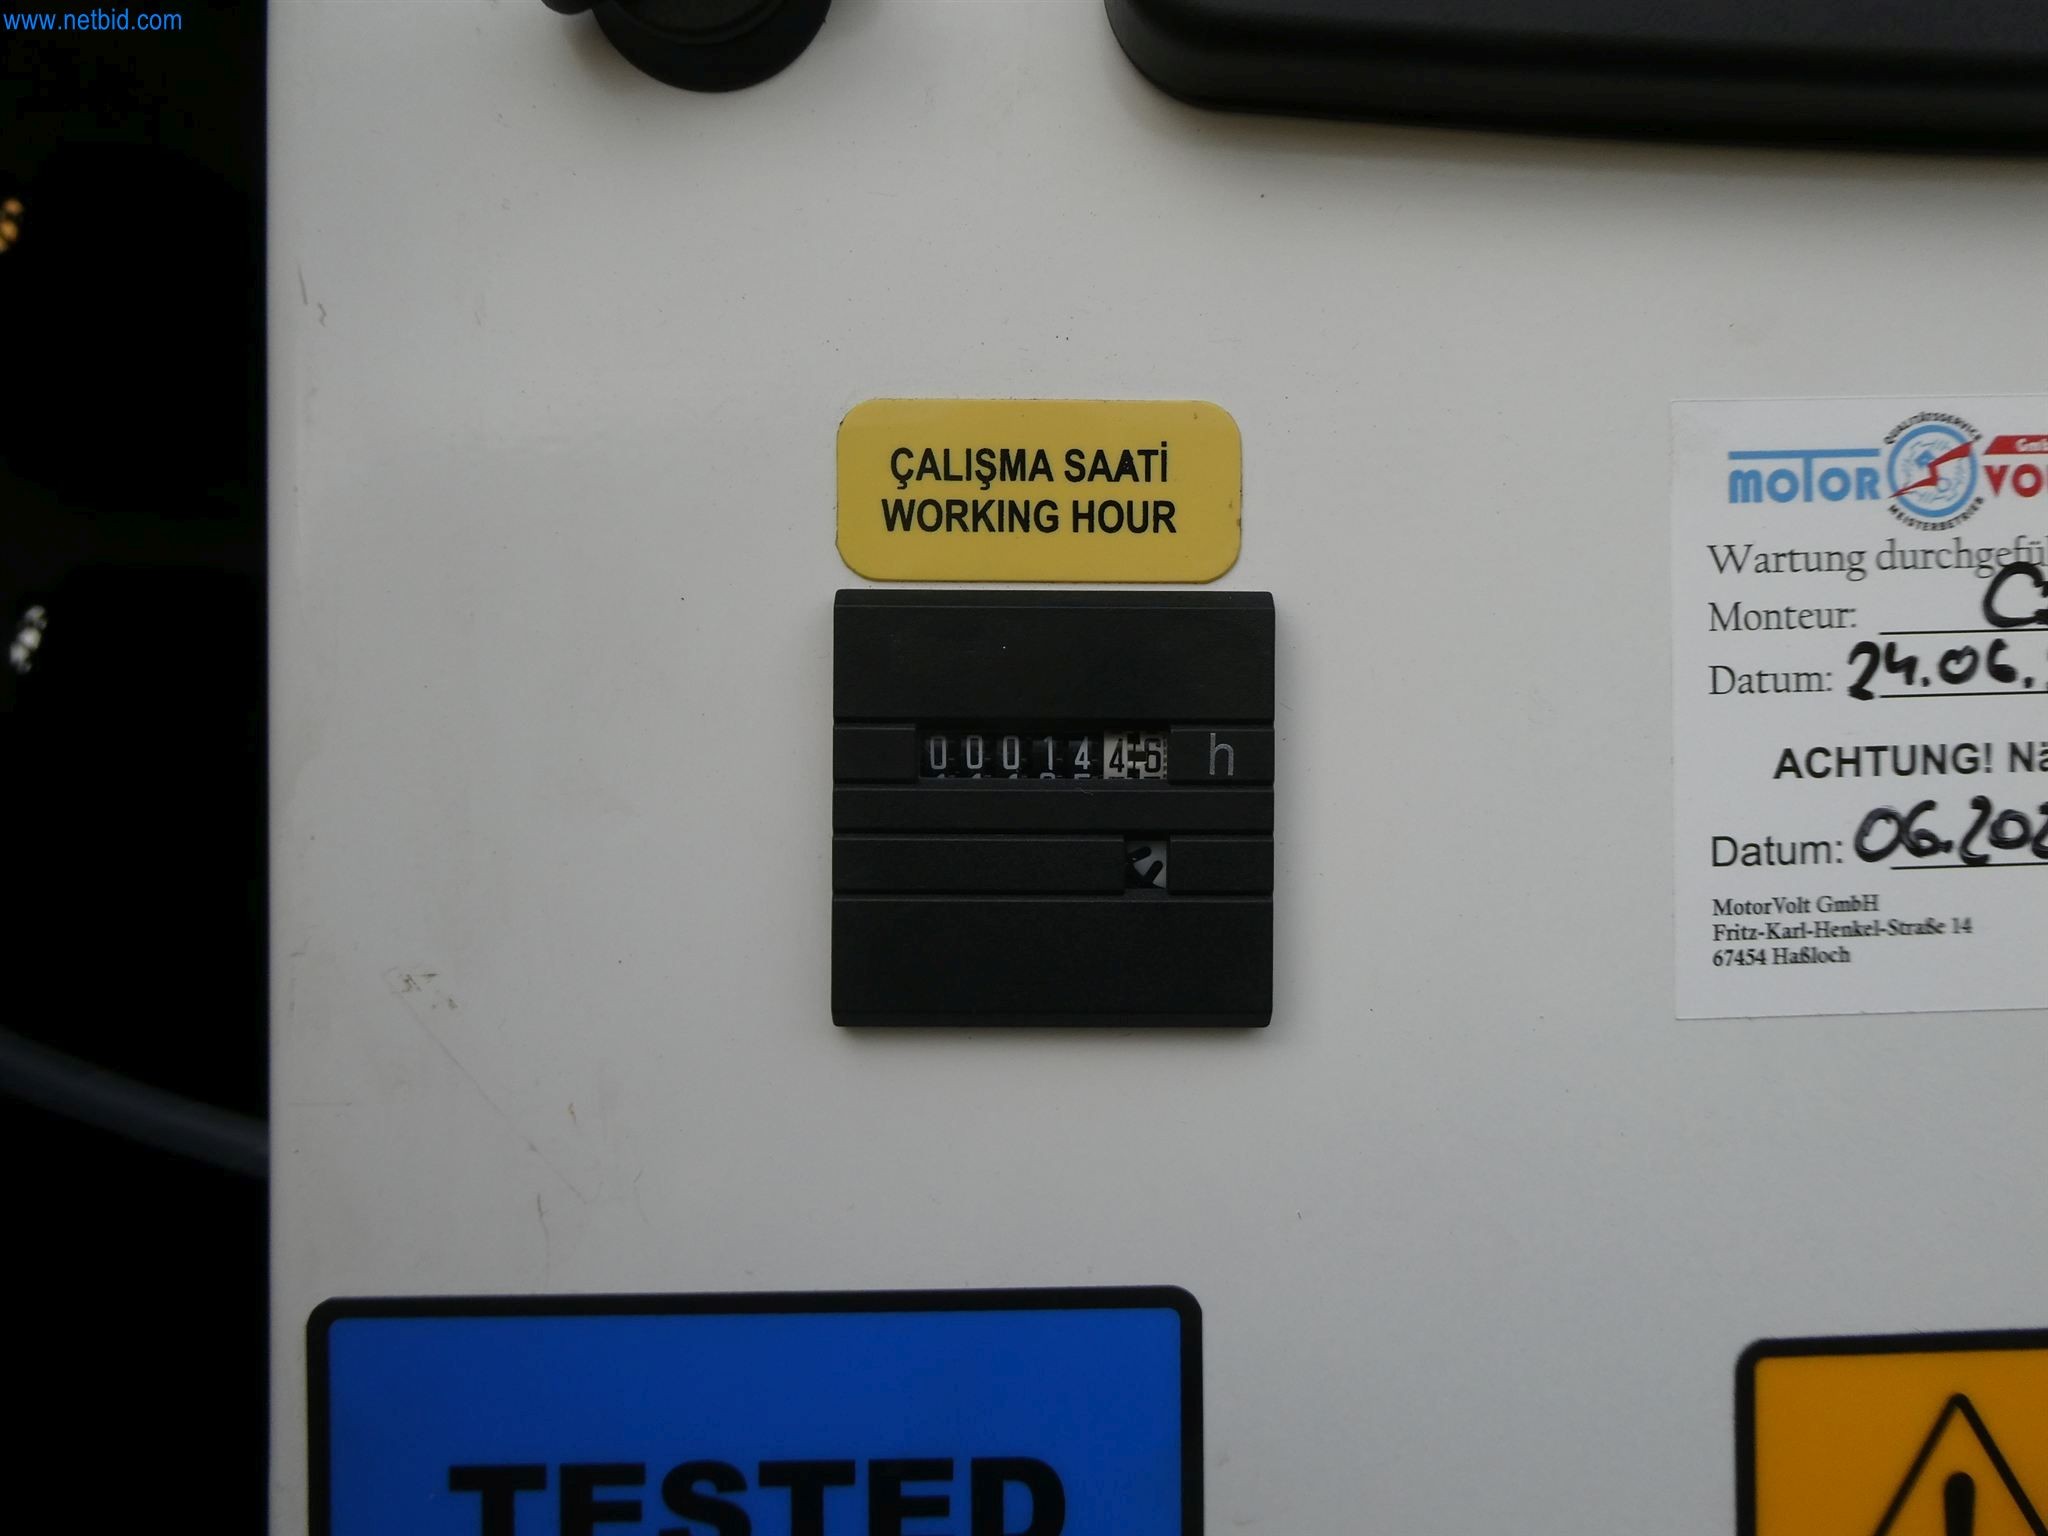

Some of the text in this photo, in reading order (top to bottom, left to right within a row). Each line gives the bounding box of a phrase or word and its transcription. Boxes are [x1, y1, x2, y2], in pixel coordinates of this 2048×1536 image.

[890, 441, 1168, 490] ÇALIŞMA SAATİ
[1984, 464, 2048, 497] VO
[881, 498, 1177, 533] WORKING HOUR
[1707, 535, 2048, 581] Wartung durchgefü
[1708, 602, 1857, 632] Monteur:
[1709, 665, 1833, 695] Datum:
[1848, 638, 2048, 701] 24.06.
[1208, 732, 1234, 776] h
[1773, 742, 1993, 780] ACHTUNG!
[1711, 836, 1844, 868] Datum:
[1712, 894, 1880, 917] MotorVolt GmbH
[1712, 917, 1973, 942] Fritz-Karl-Henkel-Straße 14
[1712, 946, 1852, 967] 67454 Haßloch
[448, 1456, 1067, 1536] TESTED
